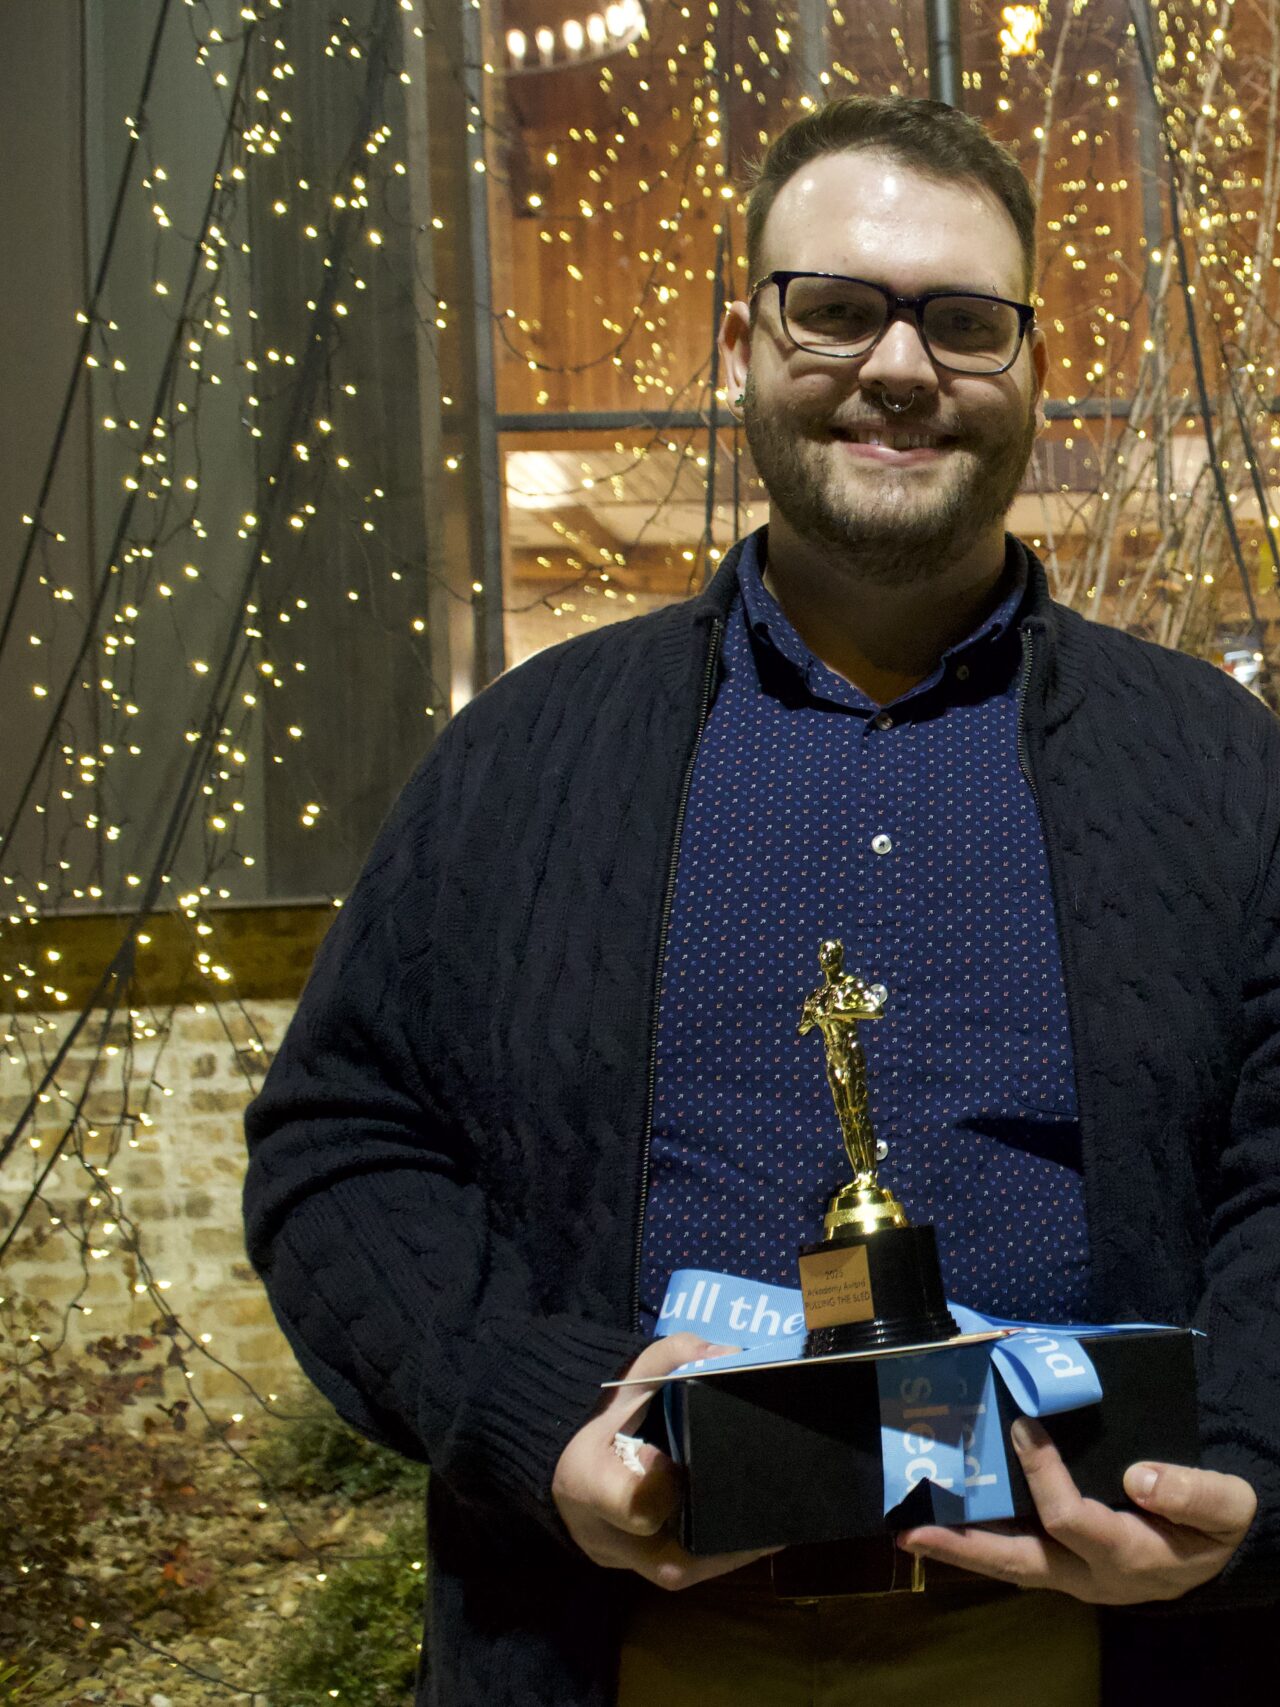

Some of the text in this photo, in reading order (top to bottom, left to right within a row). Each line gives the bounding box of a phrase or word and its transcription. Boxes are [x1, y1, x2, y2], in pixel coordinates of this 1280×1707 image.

[836, 1293, 852, 1305] THE
[852, 1290, 870, 1303] SLED
[729, 1294, 805, 1336] the
